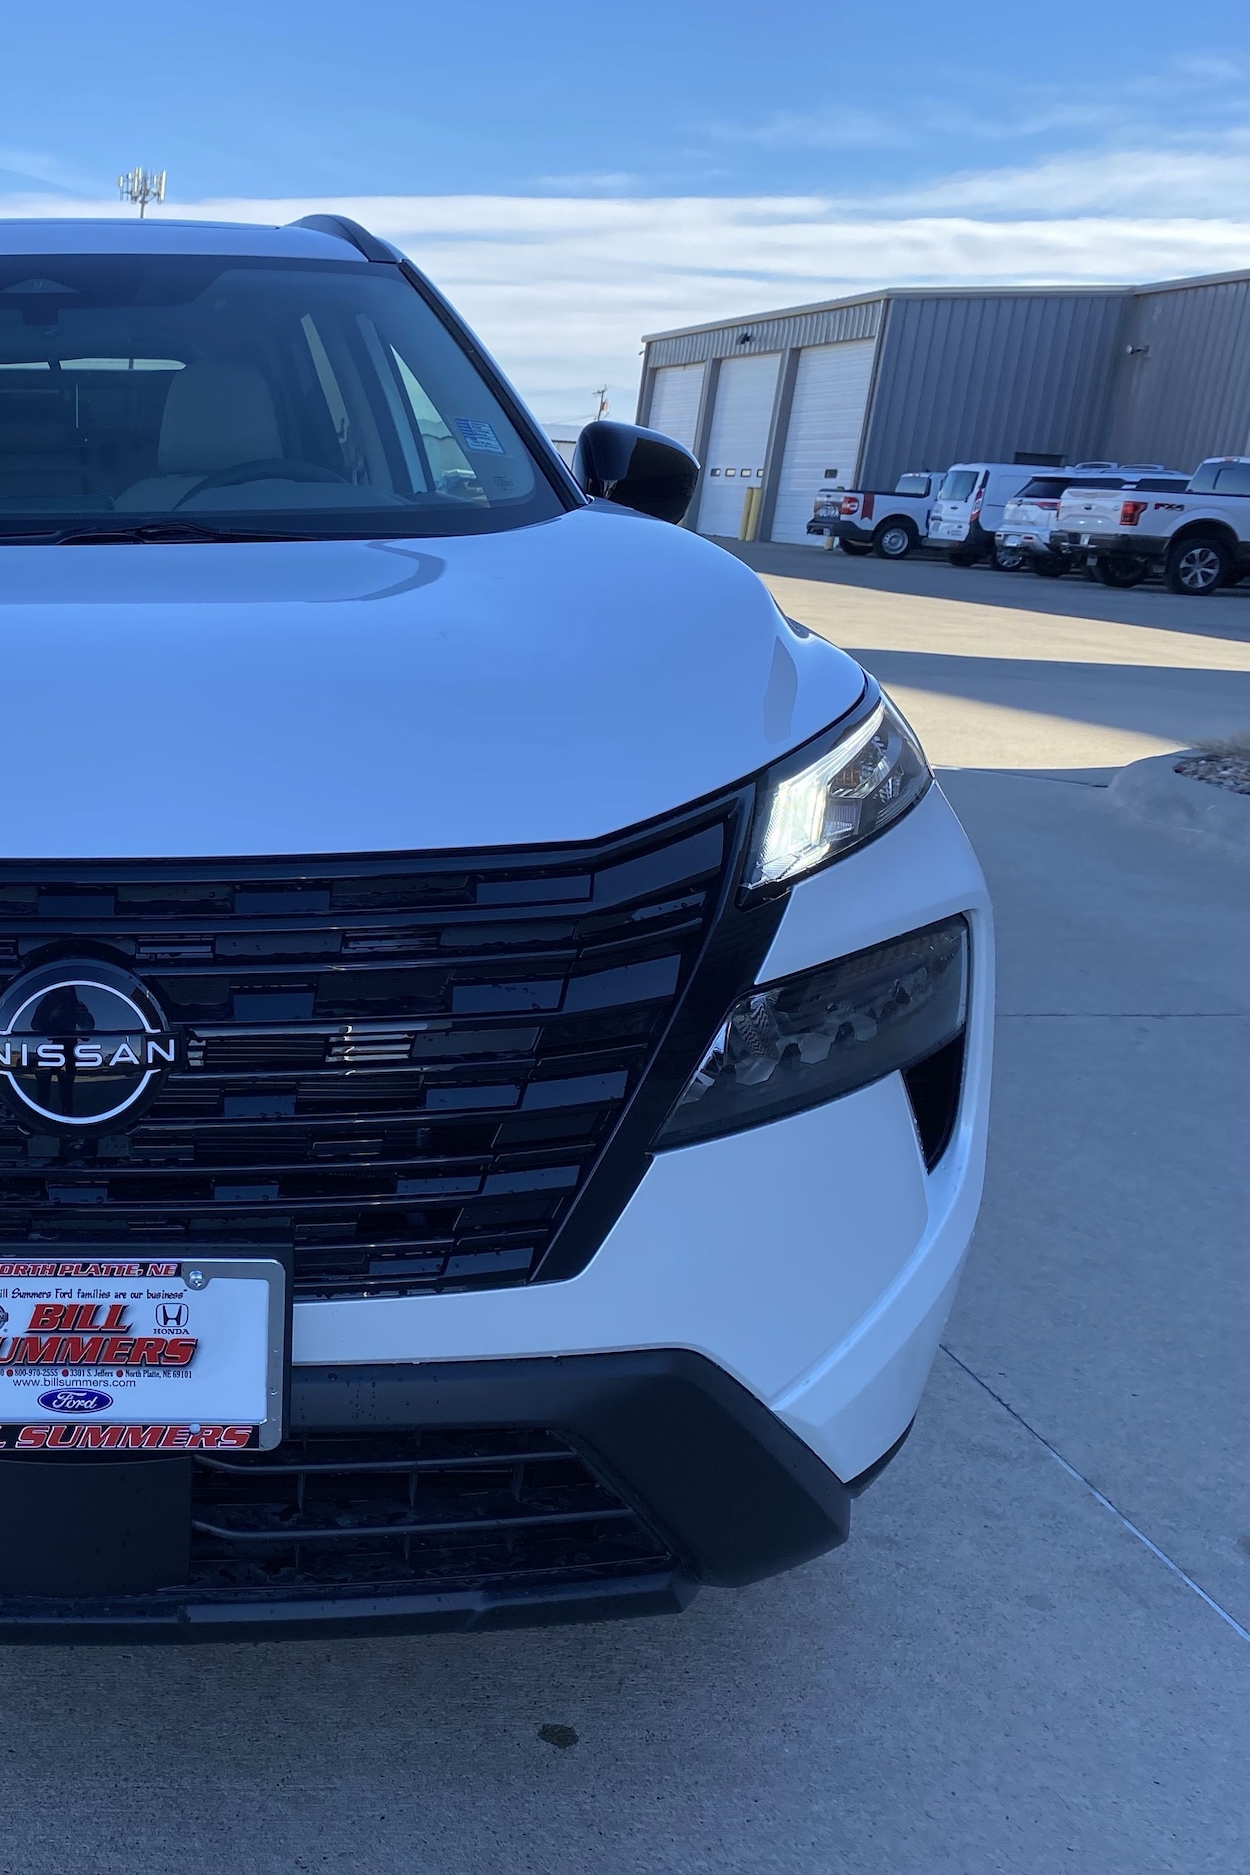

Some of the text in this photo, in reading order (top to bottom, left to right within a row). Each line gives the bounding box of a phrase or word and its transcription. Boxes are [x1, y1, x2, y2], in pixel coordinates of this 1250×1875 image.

[57, 1263, 143, 1277] PLATTE,
[146, 1263, 178, 1277] NE
[11, 1287, 52, 1299] Summers
[55, 1288, 73, 1299] Ford
[77, 1288, 111, 1299] families
[114, 1291, 127, 1299] are
[130, 1291, 143, 1299] our
[25, 1303, 133, 1333] BILL
[14, 1368, 59, 1377] 800-970-2555
[69, 1369, 85, 1377] 3301
[86, 1369, 92, 1377] S.
[93, 1369, 114, 1378] Jeffers
[125, 1369, 141, 1378] North
[142, 1369, 161, 1379] Platte,
[163, 1370, 172, 1378] NE
[173, 1370, 192, 1379] 69101
[12, 1378, 136, 1388] www.billsummers.com
[52, 1391, 99, 1409] Ford
[15, 1425, 253, 1448] SUMMERS
